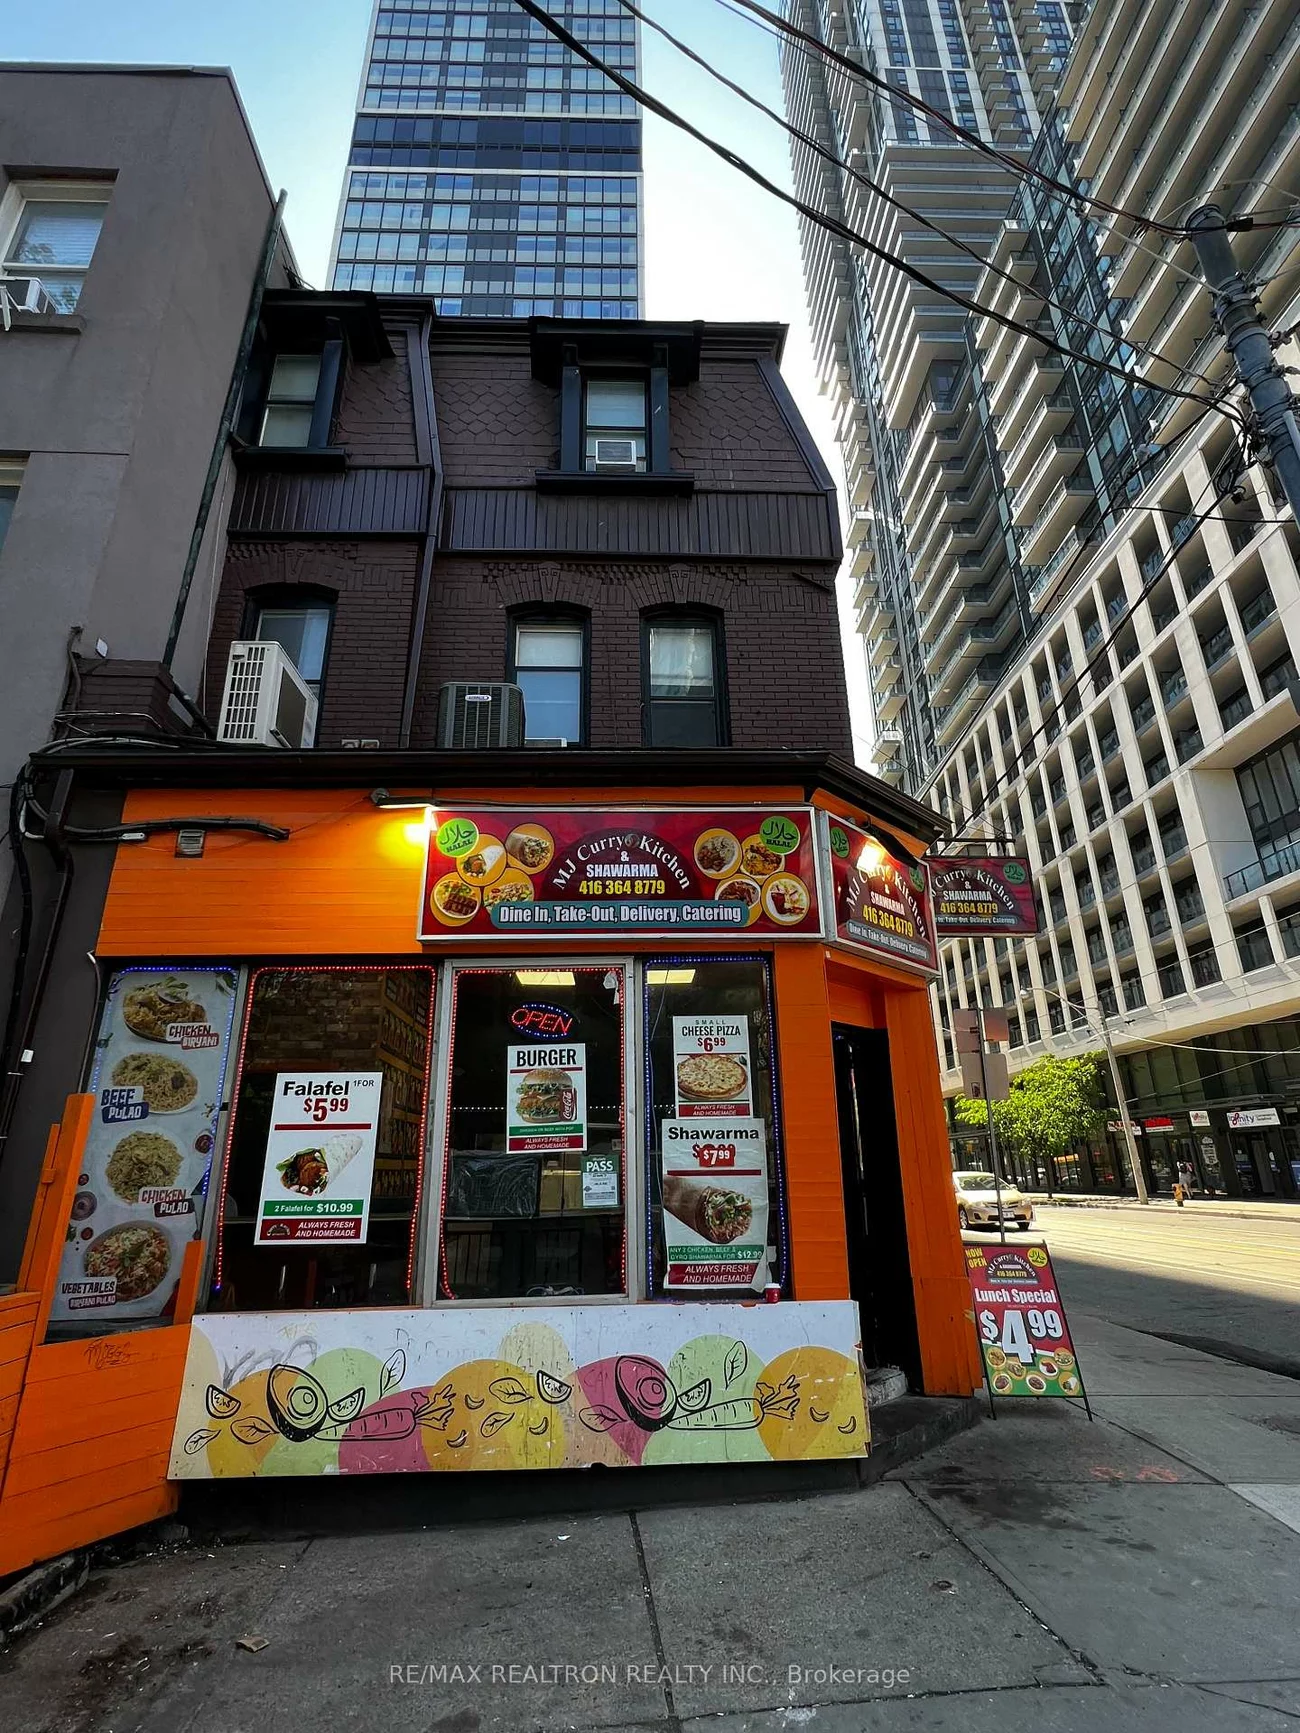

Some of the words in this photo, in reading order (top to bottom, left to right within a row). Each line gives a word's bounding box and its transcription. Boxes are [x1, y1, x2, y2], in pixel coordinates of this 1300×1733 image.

[446, 838, 473, 853] HALAL
[553, 859, 577, 890] MJ
[577, 836, 625, 861] Curry
[639, 835, 690, 889] Kitchen
[620, 851, 629, 861] &
[586, 864, 658, 877] SHAWARMA
[579, 880, 602, 895] 416
[605, 880, 631, 894] 364
[634, 880, 665, 894] 8779
[935, 869, 965, 888] Curry
[976, 869, 1014, 910] Kitchen
[943, 890, 992, 900] SHAWARMA
[870, 891, 905, 916] SHAWARMA
[894, 870, 926, 938] Kitchen
[940, 902, 956, 913] 416
[958, 902, 976, 913] 364
[977, 902, 998, 913] 8779
[500, 906, 532, 922] Dine
[534, 906, 552, 923] In,
[554, 905, 618, 923] Take-Out,
[620, 904, 680, 922] Delivery,
[682, 904, 742, 923] Catering
[863, 904, 878, 924] 416
[879, 910, 895, 931] 364
[895, 917, 914, 938] 8779
[511, 1008, 573, 1034] OPEN
[169, 1025, 211, 1037] CHICKEN
[682, 1026, 714, 1036] CHEESE
[717, 1026, 741, 1036] PIZZA
[183, 1036, 218, 1048] BIRYANI
[516, 1048, 577, 1067] BURGER
[283, 1081, 349, 1096] Falafel
[101, 1089, 135, 1106] BEEF
[668, 1127, 759, 1140] Shawarma
[586, 1161, 613, 1172] PASS
[141, 1189, 186, 1203] CHICKEN
[280, 1204, 302, 1212] Falafel
[316, 1203, 353, 1213] $10.99
[312, 1229, 356, 1237] HOMEMADE
[965, 1247, 983, 1258] NOW
[685, 1265, 719, 1273] ALWAYS
[968, 1257, 987, 1269] OPEN
[703, 1275, 752, 1283] HOMEMADE
[62, 1281, 115, 1294] VEGETABLES
[975, 1288, 1011, 1302] Lunch
[1011, 1288, 1057, 1304] Special
